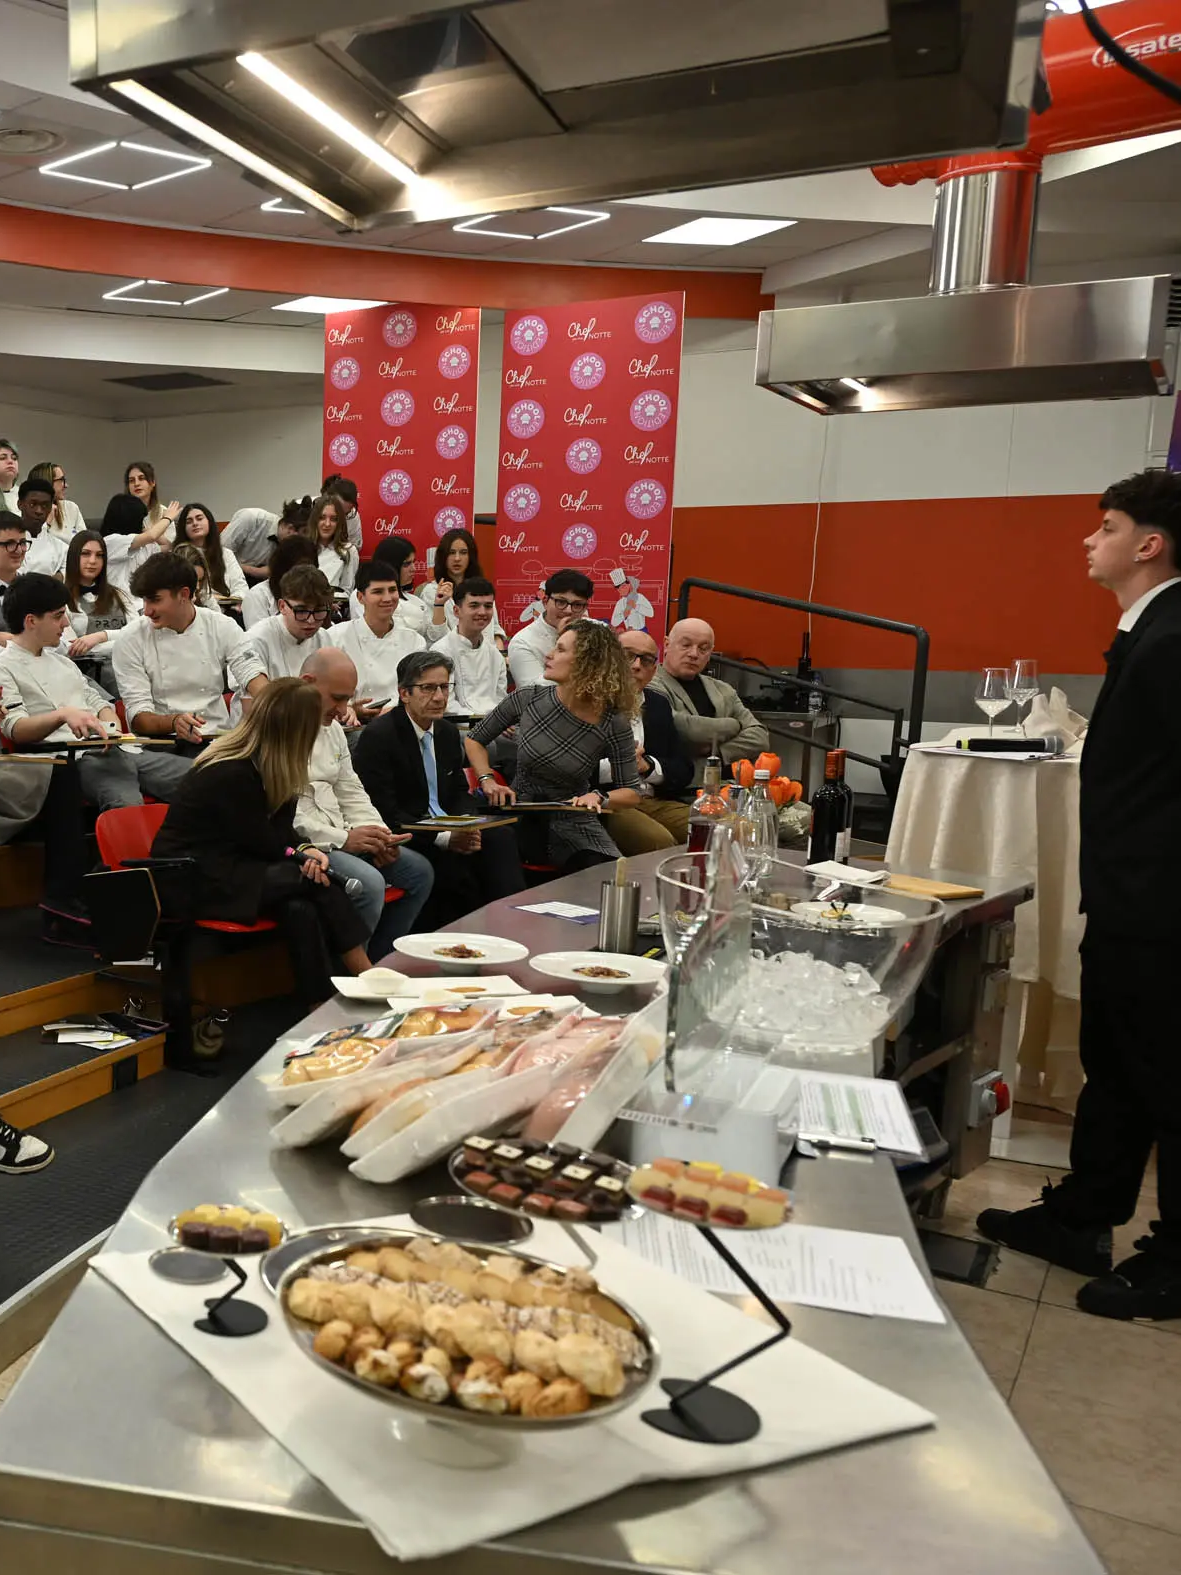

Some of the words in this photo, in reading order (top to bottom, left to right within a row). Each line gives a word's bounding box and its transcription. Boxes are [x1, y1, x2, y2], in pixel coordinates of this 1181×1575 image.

[387, 314, 415, 329] SCHOOL
[436, 312, 462, 334] Chef
[455, 324, 475, 332] NOTTE
[639, 305, 673, 324] SCHOOL
[328, 325, 351, 346] Chef
[514, 320, 544, 336] SCHOOL
[568, 318, 596, 341] Chef
[588, 331, 612, 339] NOTTE
[442, 347, 467, 362] SCHOOL
[573, 356, 603, 372] SCHOOL
[333, 360, 357, 374] SCHOOL
[379, 358, 403, 379] Chef
[628, 354, 658, 379] Chef
[651, 368, 675, 376] NOTTE
[505, 366, 532, 388] Chef
[524, 379, 547, 387] NOTTE
[385, 392, 411, 408] SCHOOL
[434, 393, 459, 415] Chef
[635, 394, 667, 411] SCHOOL
[327, 402, 350, 423] Chef
[511, 403, 541, 420] SCHOOL
[564, 403, 592, 427] Chef
[332, 437, 356, 450] SCHOOL
[439, 428, 466, 443] SCHOOL
[377, 436, 401, 457] Chef
[569, 441, 598, 457] SCHOOL
[624, 442, 654, 465] Chef
[645, 456, 669, 464] NOTTE
[502, 448, 528, 471] Chef
[382, 472, 409, 489] SCHOOL
[431, 475, 456, 496] Chef
[507, 487, 537, 504] SCHOOL
[630, 482, 663, 500] SCHOOL
[560, 490, 588, 513] Chef
[437, 509, 463, 523] SCHOOL
[374, 516, 399, 536] Chef
[566, 527, 595, 543] SCHOOL
[498, 532, 525, 553] Chef
[619, 530, 649, 553] Chef
